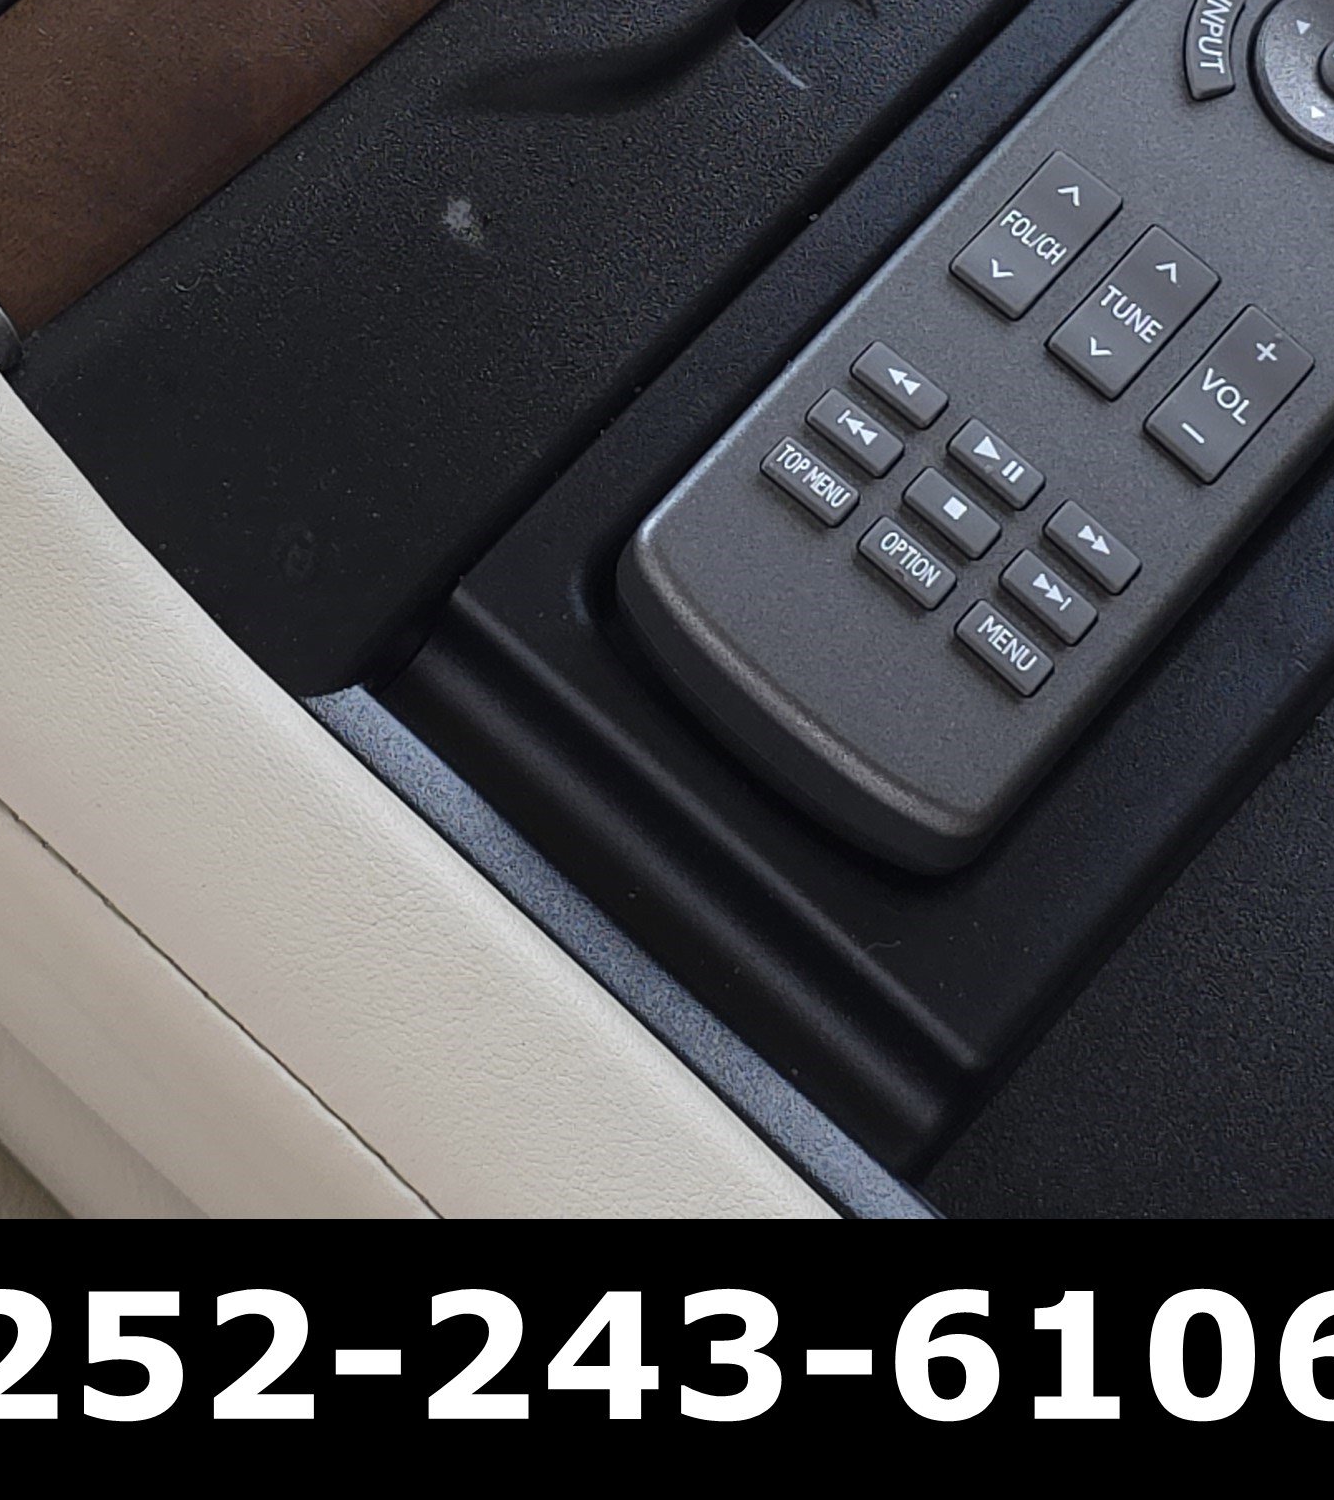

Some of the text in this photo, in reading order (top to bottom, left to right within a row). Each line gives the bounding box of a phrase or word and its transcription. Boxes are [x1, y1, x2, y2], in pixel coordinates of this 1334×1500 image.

[999, 209, 1067, 267] FOL/CH
[1098, 284, 1163, 345] TUNE
[1201, 367, 1250, 426] VOL
[776, 443, 851, 509] TOP MENU
[880, 531, 942, 588] OPTION
[976, 614, 1038, 672] MENU
